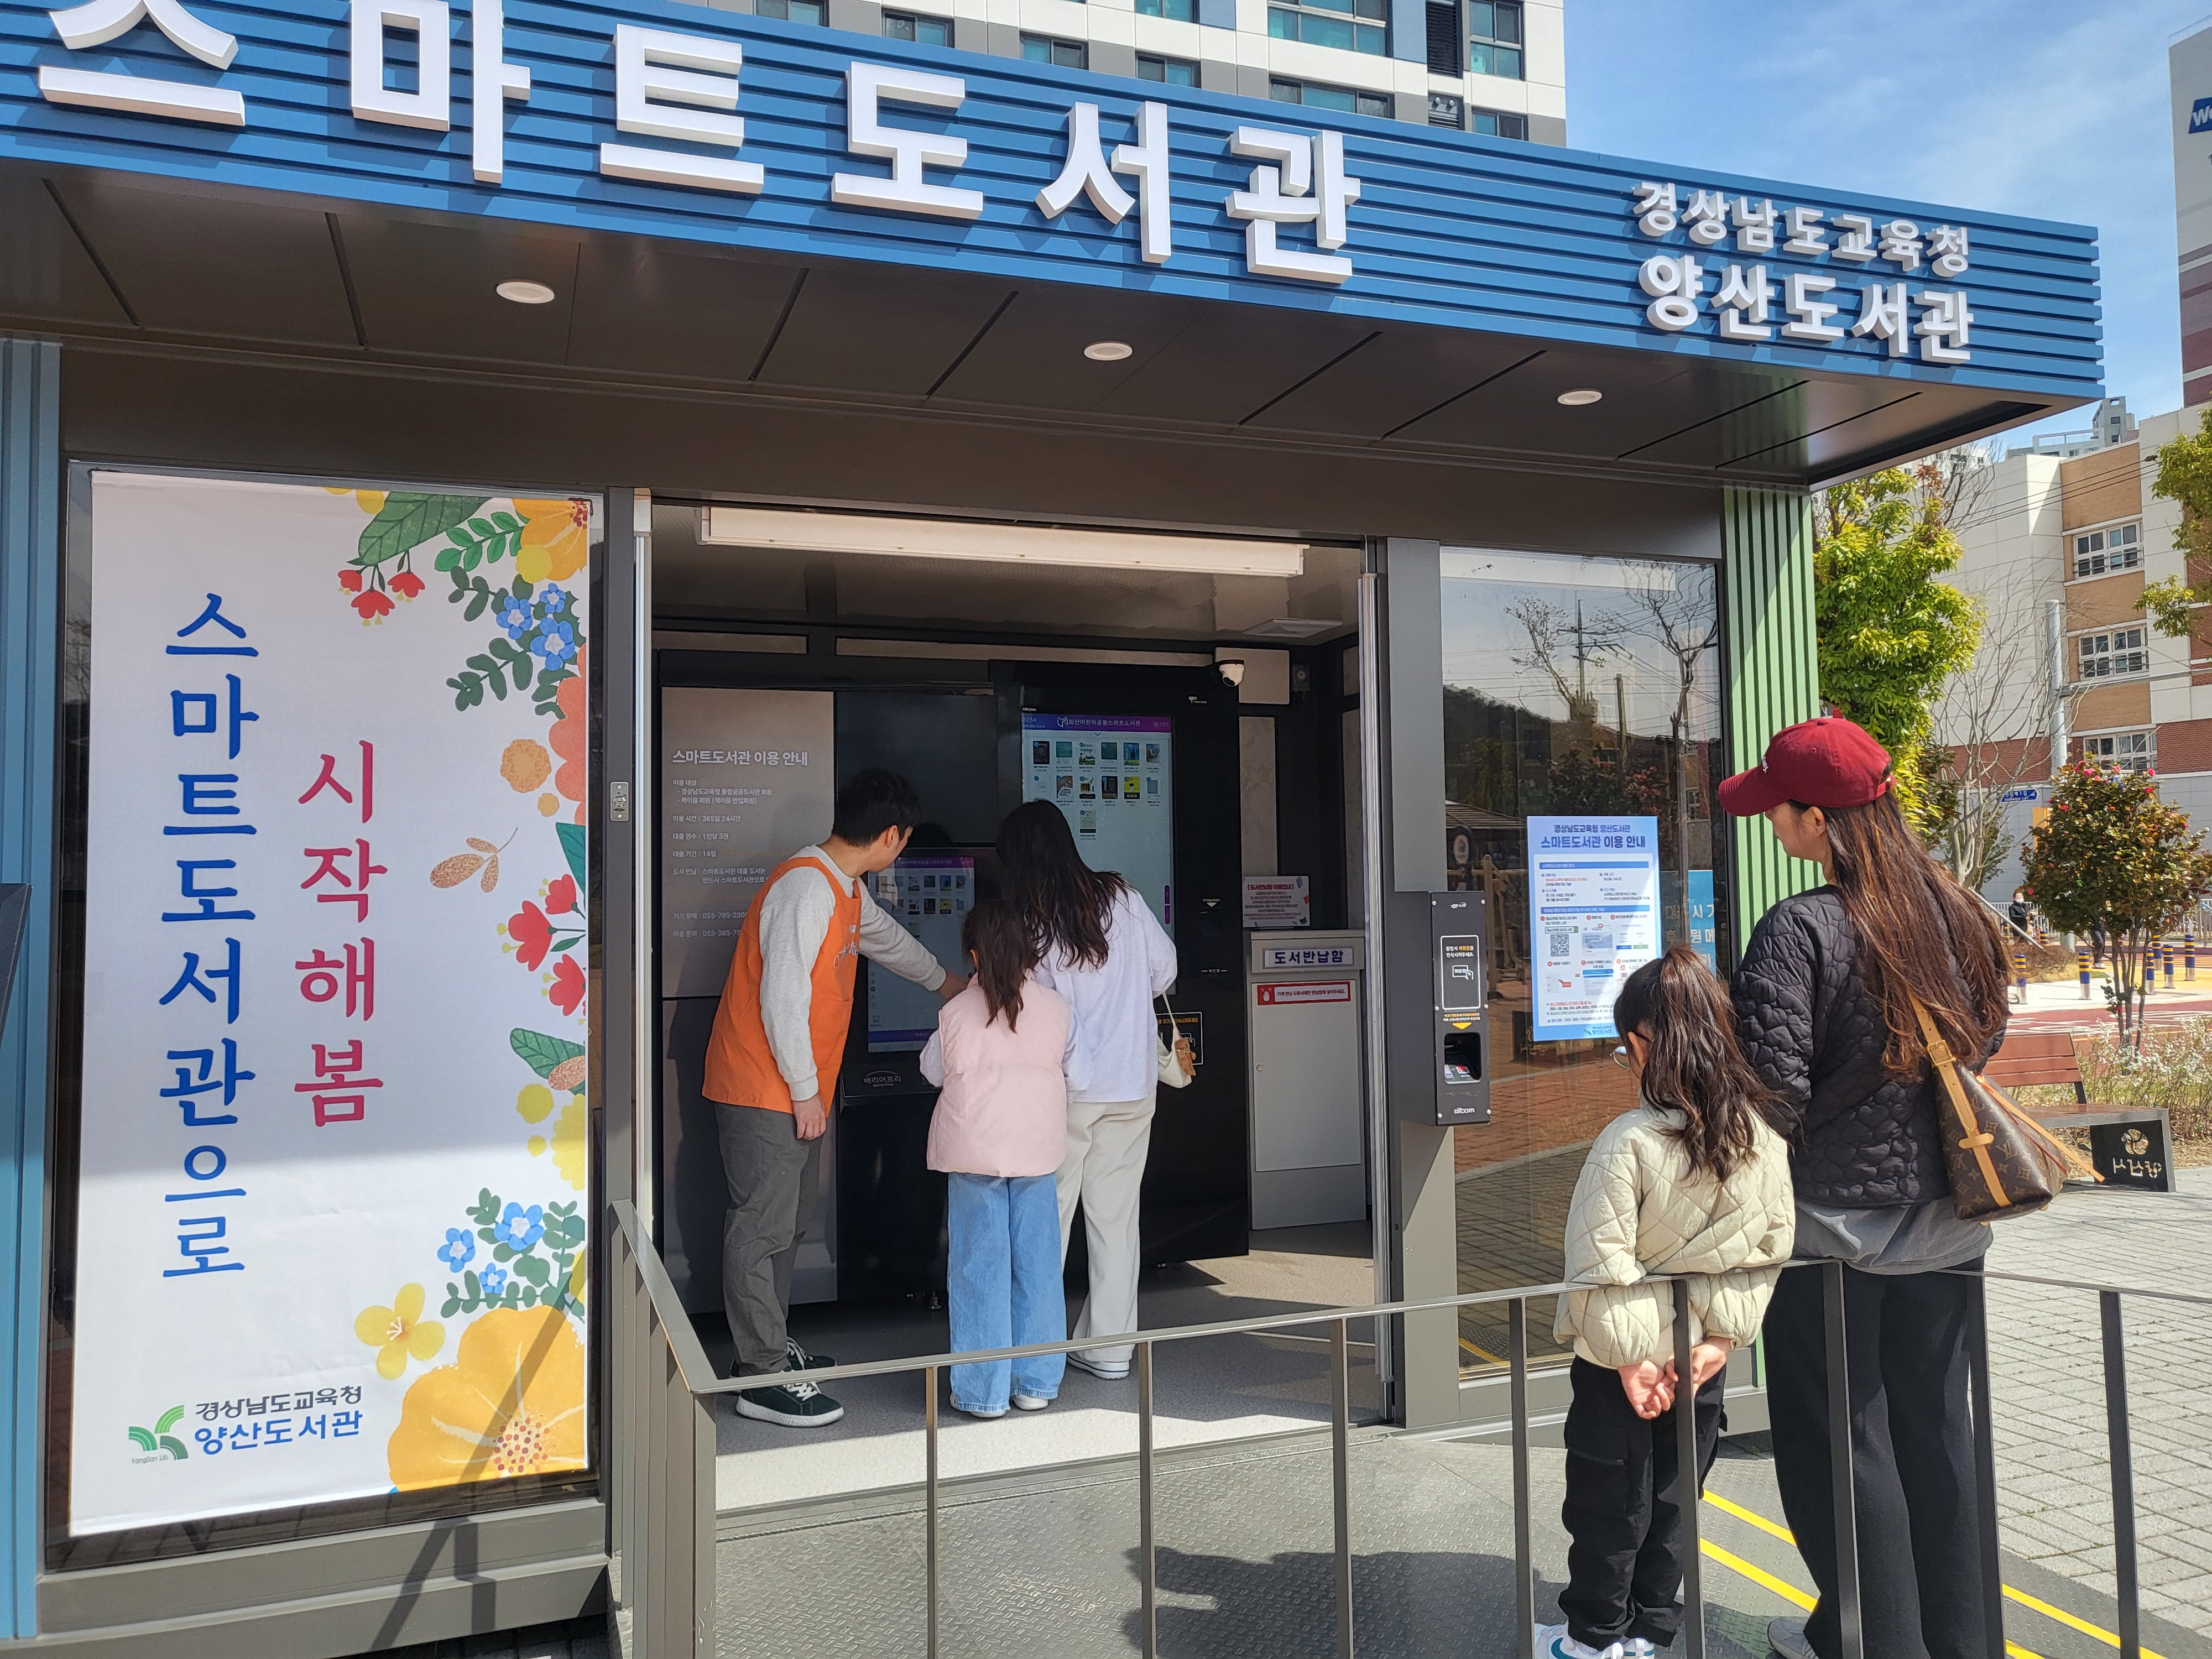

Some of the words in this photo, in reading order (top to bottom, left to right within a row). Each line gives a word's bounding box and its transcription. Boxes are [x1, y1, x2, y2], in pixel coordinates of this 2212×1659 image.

[39, 0, 1361, 284] 스마트도서관
[1632, 182, 1969, 278] 경상남도교육청
[1639, 254, 1974, 364] 양산도서관
[672, 750, 751, 765] 스마트도서관
[754, 751, 780, 765] 이용
[782, 751, 808, 766] 안내
[1541, 836, 1601, 848] 스마트도서관
[1604, 836, 1623, 848] 이용
[1626, 836, 1646, 848] 안내
[1554, 825, 1598, 833] 경상남도교육청
[1600, 824, 1631, 833] 양산도서관
[159, 593, 259, 1277] 스마트도서관으로
[294, 740, 388, 1127] 시작해봄
[1274, 950, 1344, 964] 도서반납함
[863, 1075, 902, 1084] 배리어프리
[195, 1386, 362, 1421] 경상남도교육청
[195, 1410, 363, 1455] 양산도서관
